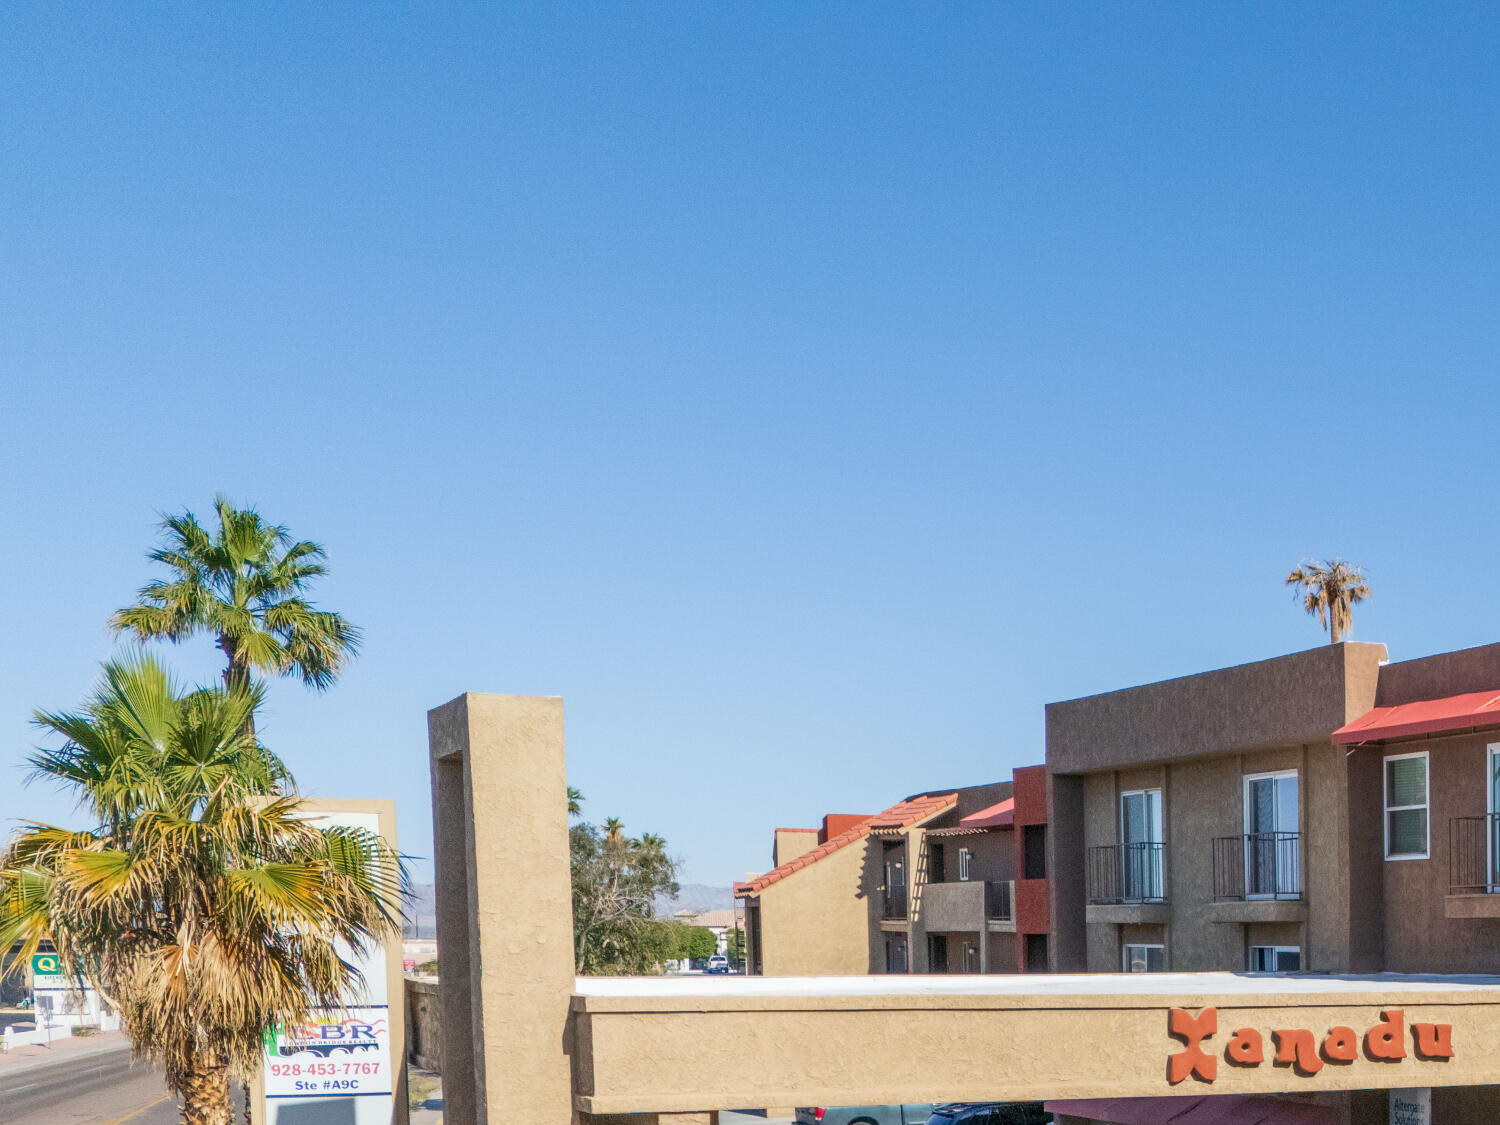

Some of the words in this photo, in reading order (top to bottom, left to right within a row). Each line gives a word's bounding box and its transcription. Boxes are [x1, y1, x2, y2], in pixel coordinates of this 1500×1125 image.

[1167, 1007, 1455, 1083] Xanadu
[271, 1063, 380, 1076] 928-453-7767
[295, 1081, 317, 1090] Ste
[323, 1080, 359, 1090] #A9C
